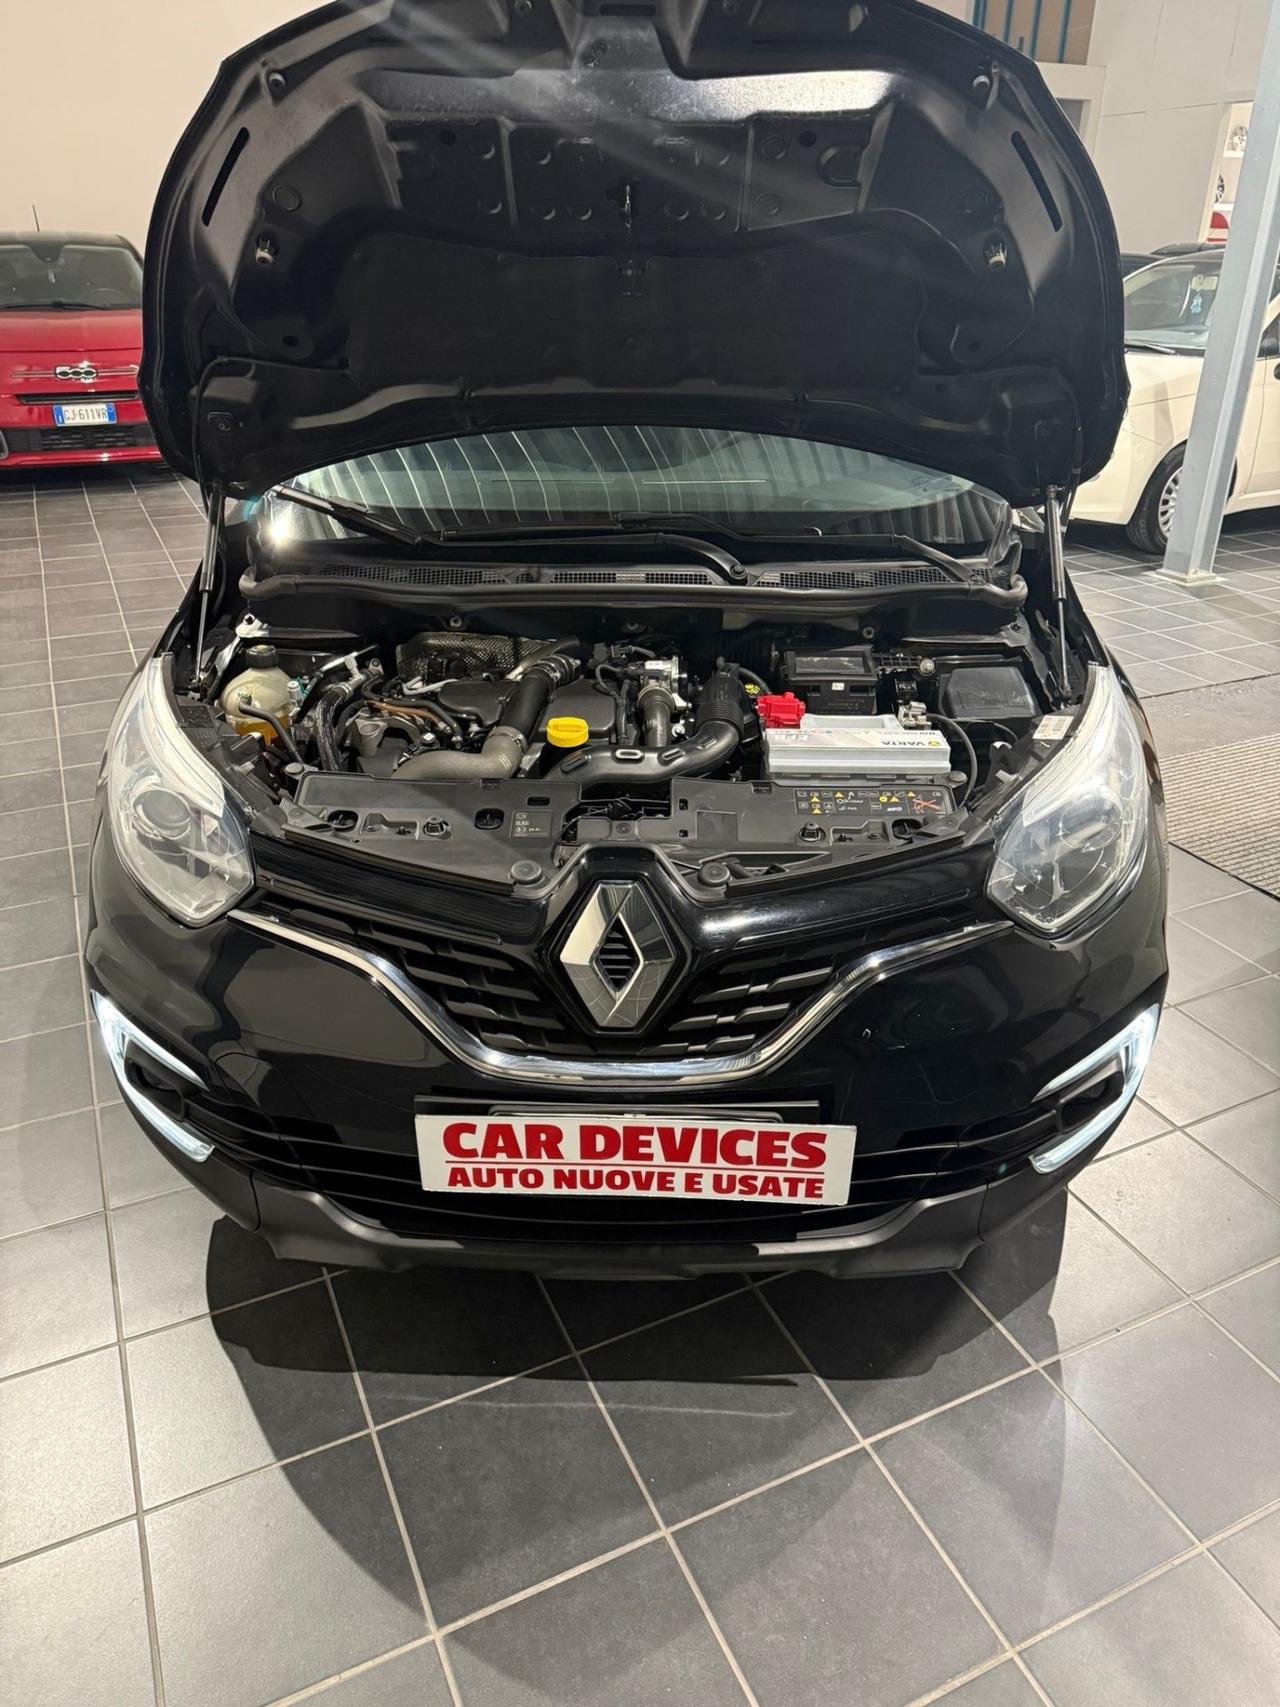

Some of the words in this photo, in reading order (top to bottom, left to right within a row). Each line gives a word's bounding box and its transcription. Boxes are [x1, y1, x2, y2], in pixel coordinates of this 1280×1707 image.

[56, 366, 97, 379] 500
[442, 1122, 565, 1161] CAR
[578, 1124, 828, 1169] DEVICES
[447, 1167, 545, 1190] AUTO
[553, 1168, 677, 1192] NUOVE
[683, 1172, 703, 1195] E
[711, 1173, 825, 1199] USATE
